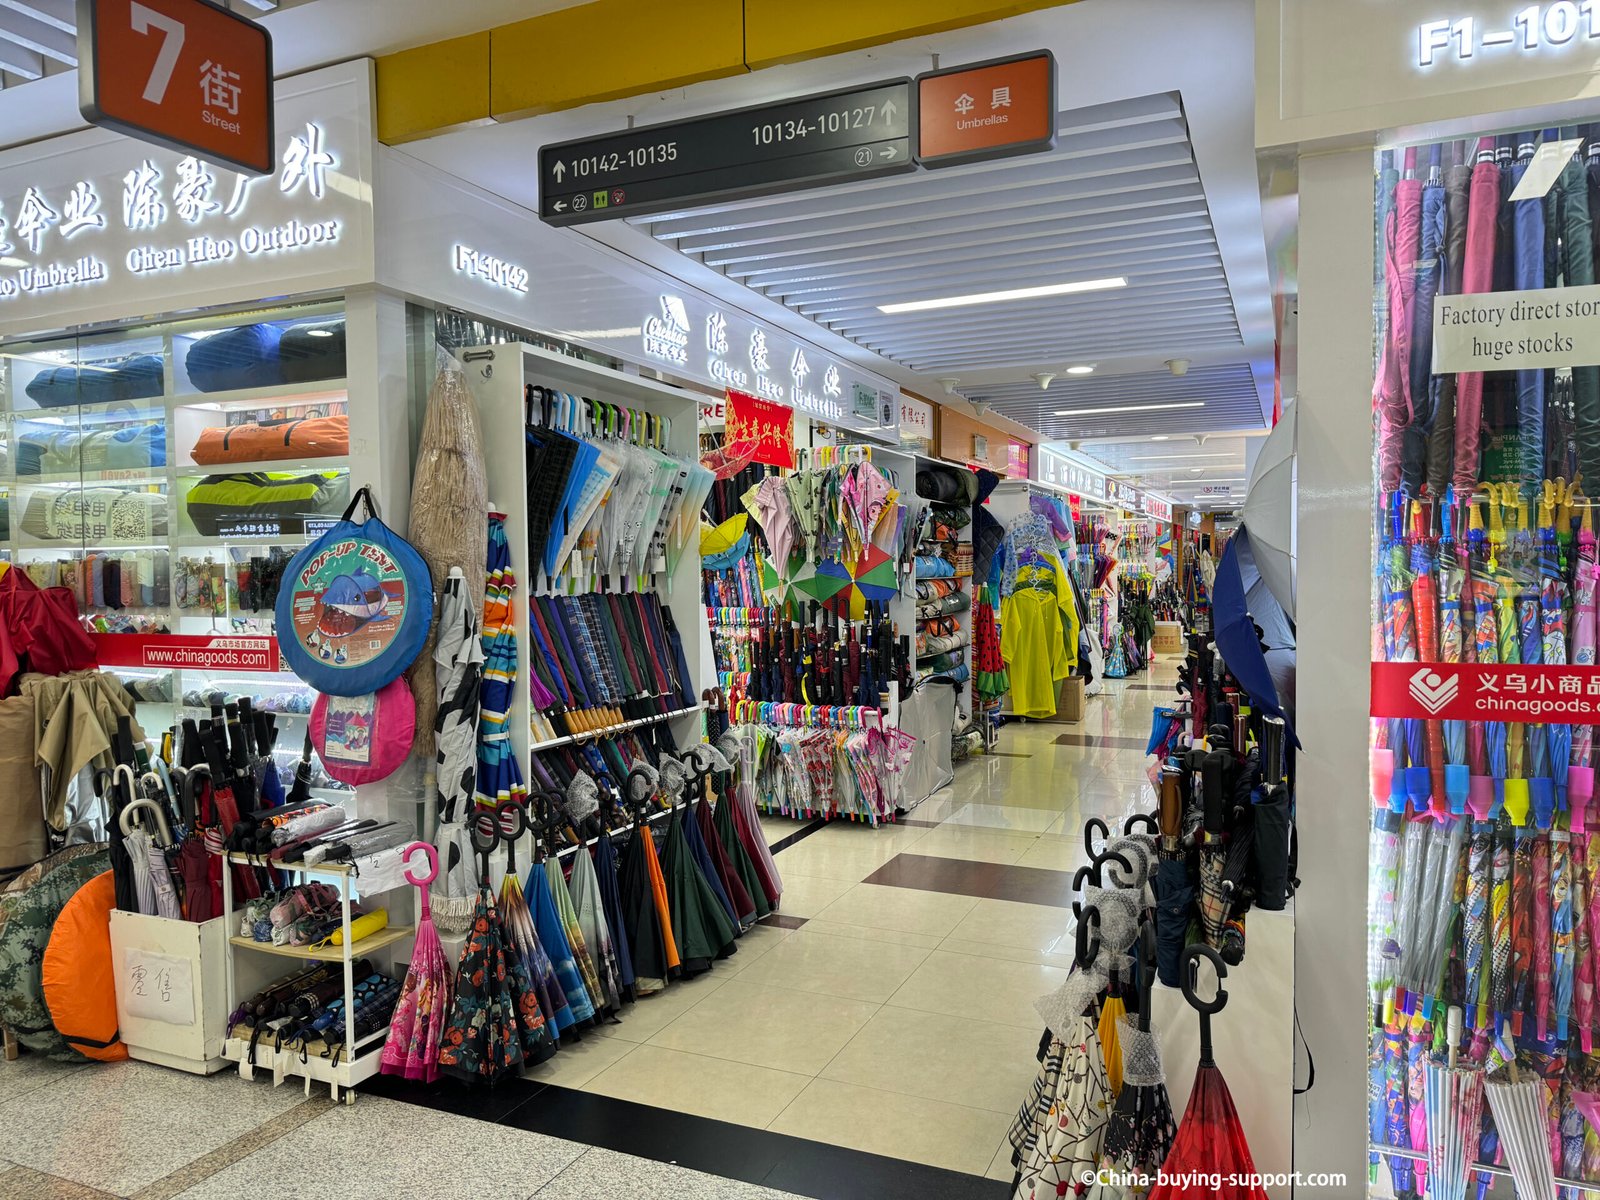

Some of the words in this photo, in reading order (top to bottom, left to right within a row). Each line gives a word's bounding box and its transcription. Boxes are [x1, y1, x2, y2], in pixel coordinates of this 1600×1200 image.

[131, 1, 185, 105] 7
[200, 59, 242, 116] 街
[954, 86, 1012, 115] 伞具
[202, 109, 241, 135] Street
[752, 106, 875, 146] 10134-10127
[956, 113, 1009, 131] Umbrellas
[571, 142, 677, 177] 10142-10135
[857, 150, 871, 164] 21
[574, 196, 586, 210] 22
[19, 255, 105, 291] Umbrella
[126, 247, 181, 273] Chen
[187, 235, 234, 263] Hao
[239, 217, 338, 253] Outdoor
[1441, 305, 1505, 328] Factory
[1510, 300, 1560, 322] direct
[1473, 336, 1513, 360] huge
[1518, 332, 1573, 354] stocks
[709, 358, 747, 386] Chen
[756, 374, 784, 399] Hao
[791, 386, 843, 419] Umbrella
[300, 542, 357, 587] POP-UP
[358, 543, 400, 574] TENT
[147, 648, 266, 667] www.chinagoods.com
[215, 639, 266, 649] 义乌市场官方网站
